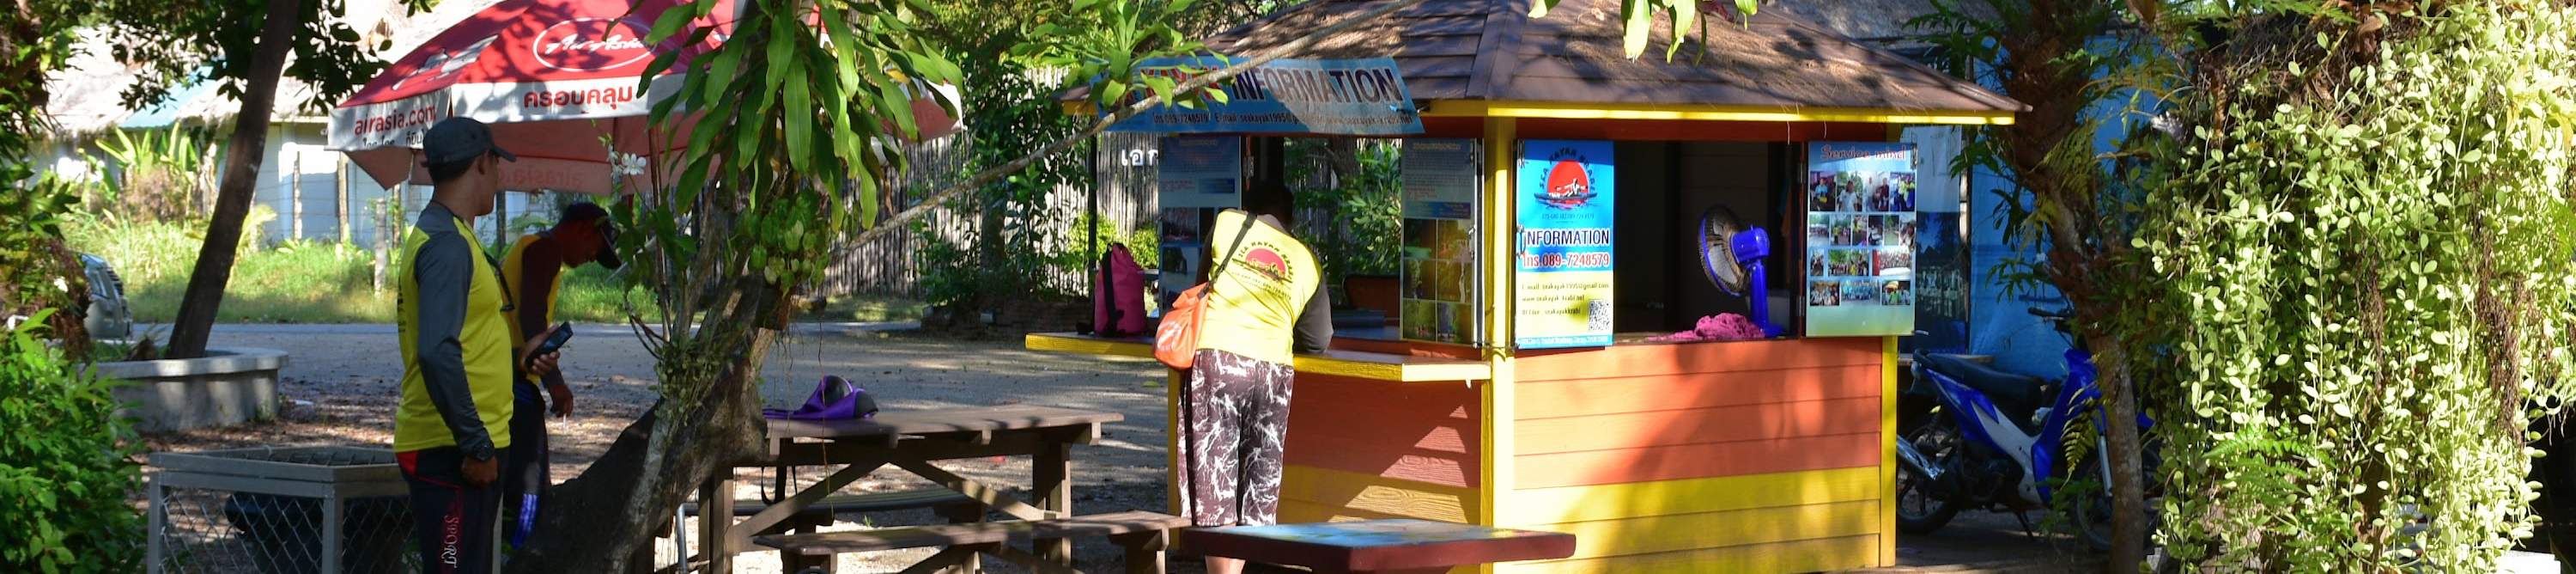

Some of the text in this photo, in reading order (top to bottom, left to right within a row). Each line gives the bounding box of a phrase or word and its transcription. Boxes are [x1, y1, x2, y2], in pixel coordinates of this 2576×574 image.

[524, 86, 633, 110] ครอบคลุม
[1231, 67, 1404, 103] INFORMATION
[354, 104, 437, 136] airasia.com
[1821, 144, 1906, 161] Service mind
[441, 516, 459, 568] SPORT
